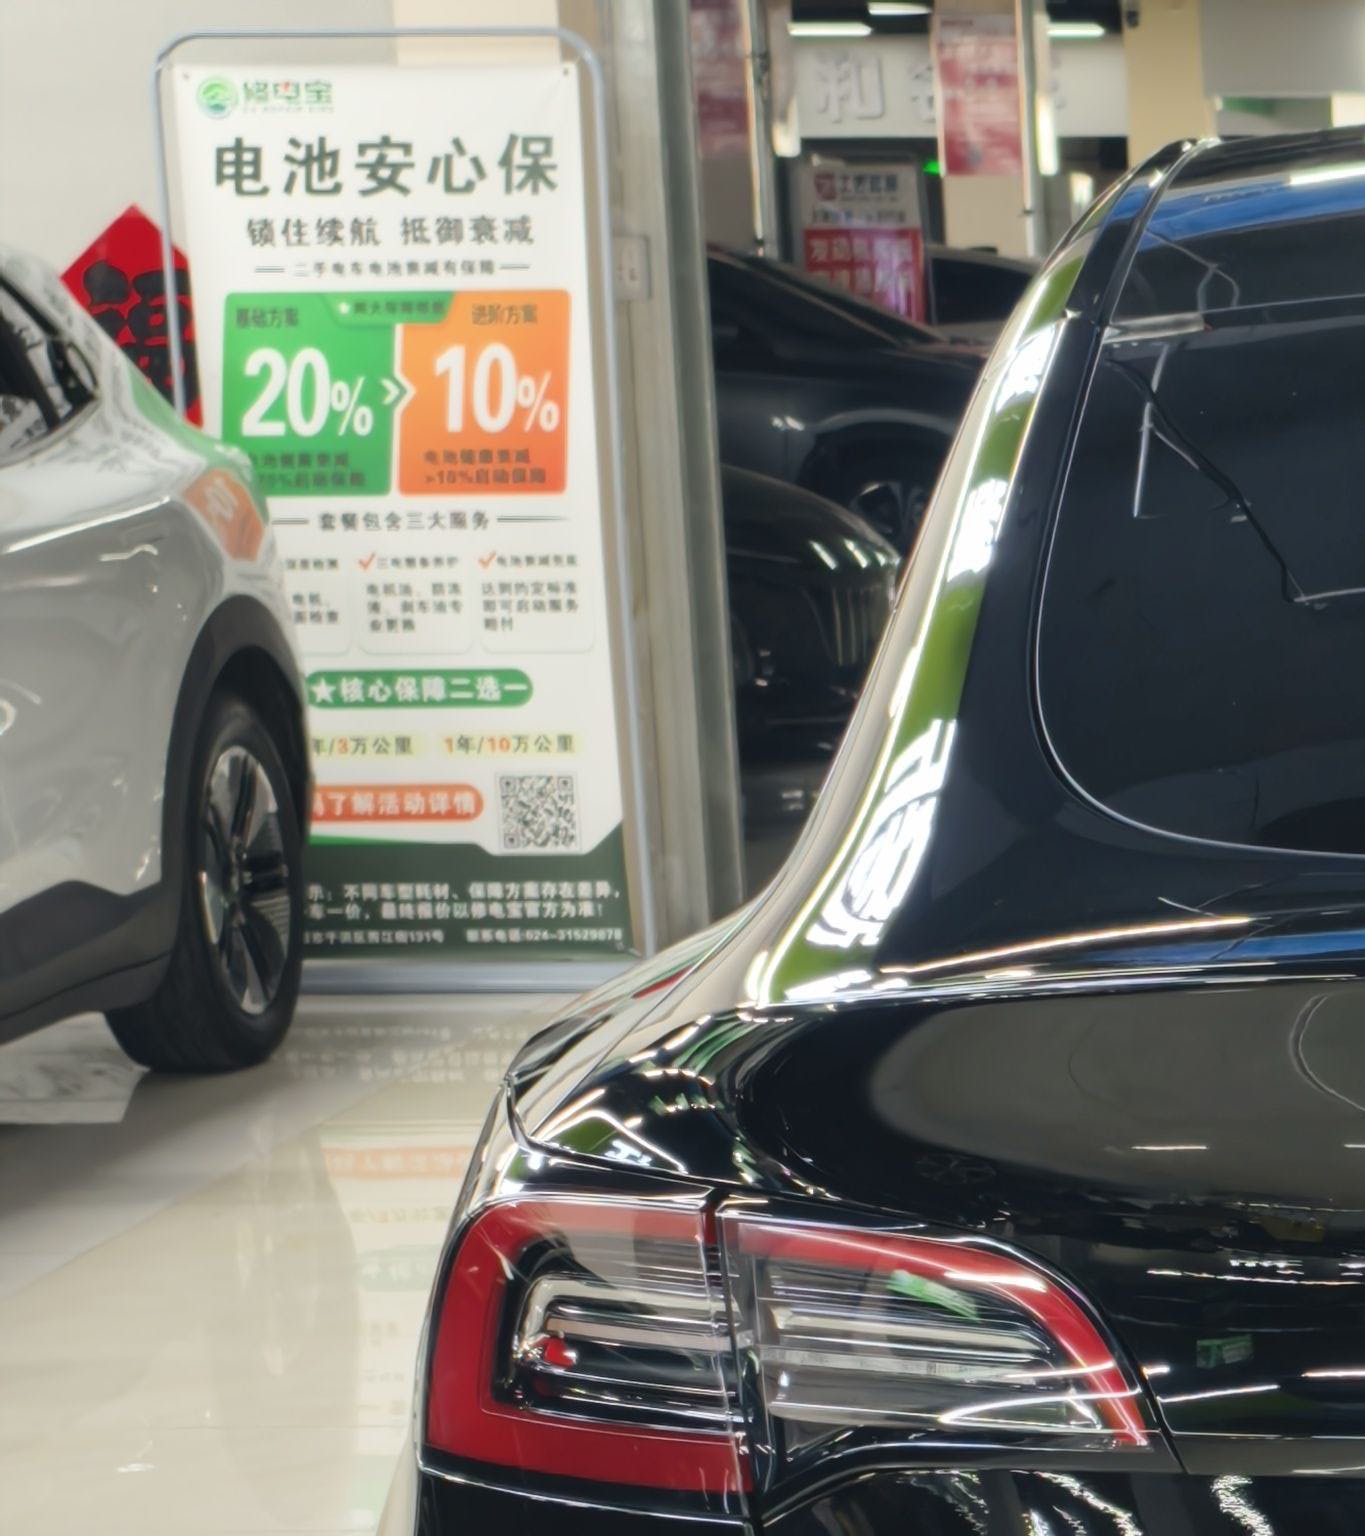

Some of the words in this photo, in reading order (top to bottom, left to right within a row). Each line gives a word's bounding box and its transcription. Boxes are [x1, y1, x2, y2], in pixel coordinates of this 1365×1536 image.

[214, 133, 558, 197] 电池安心保
[247, 216, 382, 247] 锁住续航
[399, 214, 534, 246] 抵御衰减
[235, 305, 300, 328] 基础方案
[471, 303, 538, 326] 进阶方案
[241, 347, 374, 437] 20%
[434, 343, 559, 434] 10%
[318, 510, 490, 532] 套餐包含三大服务
[340, 675, 528, 703] 核心保障二选一
[444, 734, 575, 755] 1年/10万公里
